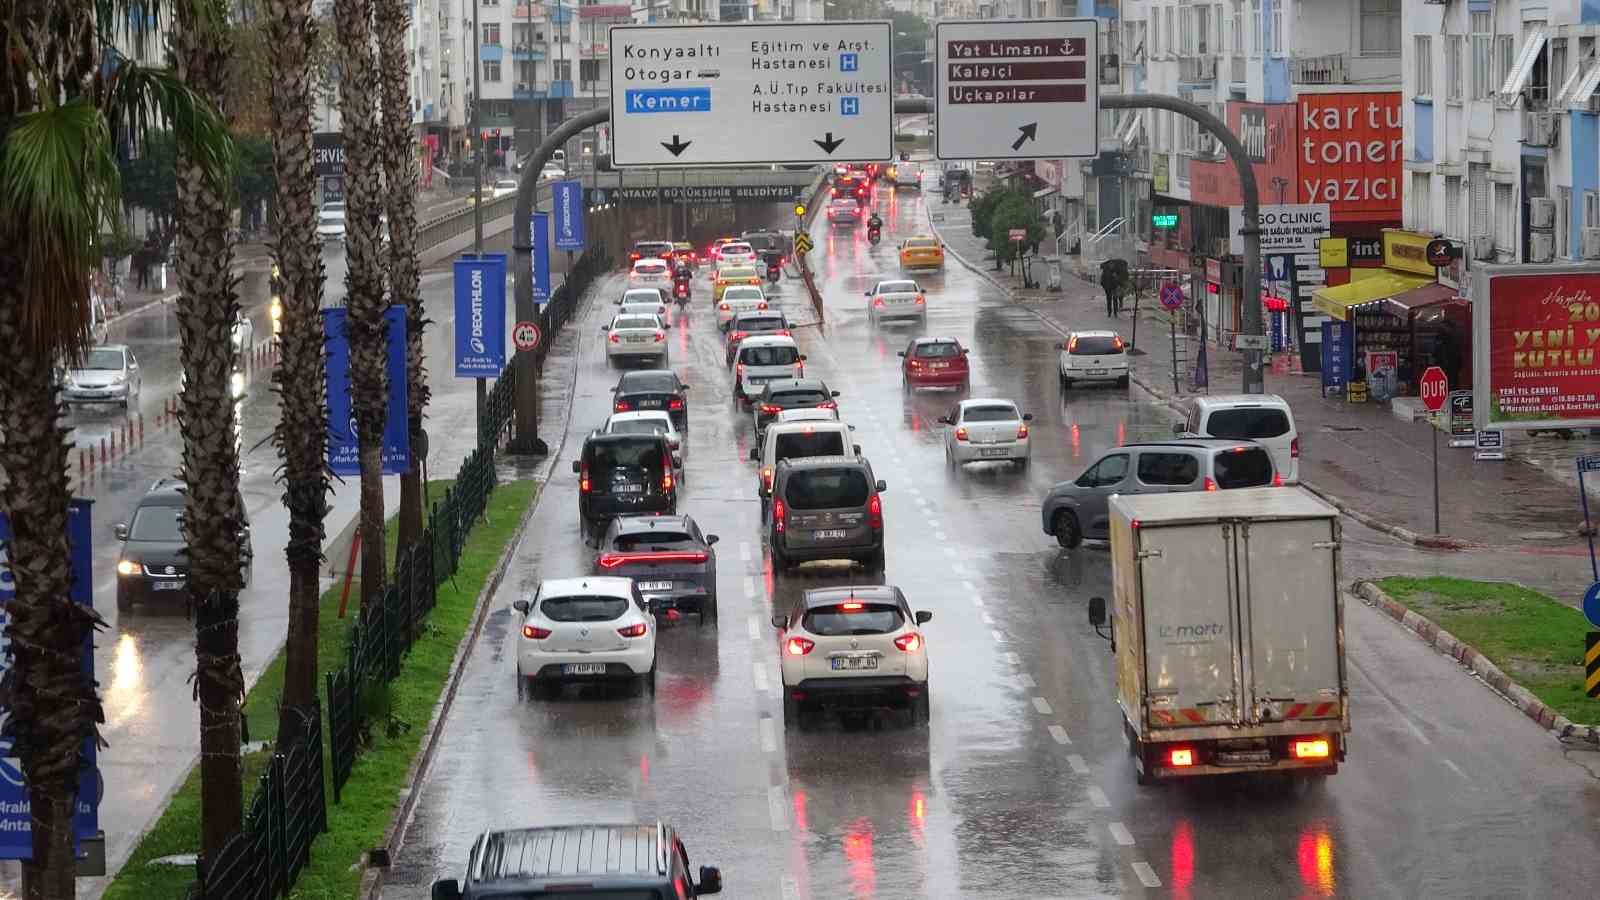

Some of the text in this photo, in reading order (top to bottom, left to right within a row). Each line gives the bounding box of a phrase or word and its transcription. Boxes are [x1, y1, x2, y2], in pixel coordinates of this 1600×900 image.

[624, 43, 720, 61] Konyaaltı
[751, 41, 804, 55] Eğitim
[812, 43, 830, 51] ve
[953, 43, 1049, 57] Yat Limanı
[752, 57, 832, 70] Hastanesi
[624, 68, 692, 84] Otogar
[817, 82, 888, 95] Fakültesi
[953, 86, 1036, 103] Üçkapılar
[632, 94, 700, 109] Kemer
[752, 101, 832, 113] Hastanesi
[1303, 136, 1403, 164] toner
[611, 190, 659, 198] ANTALYA
[1304, 178, 1397, 206] yazıcı
[1280, 212, 1323, 224] CLINIC
[471, 269, 482, 338] DECATHLON
[1514, 325, 1575, 347] YENİ
[1514, 349, 1594, 369] KUTLU
[1422, 380, 1446, 398] DUR
